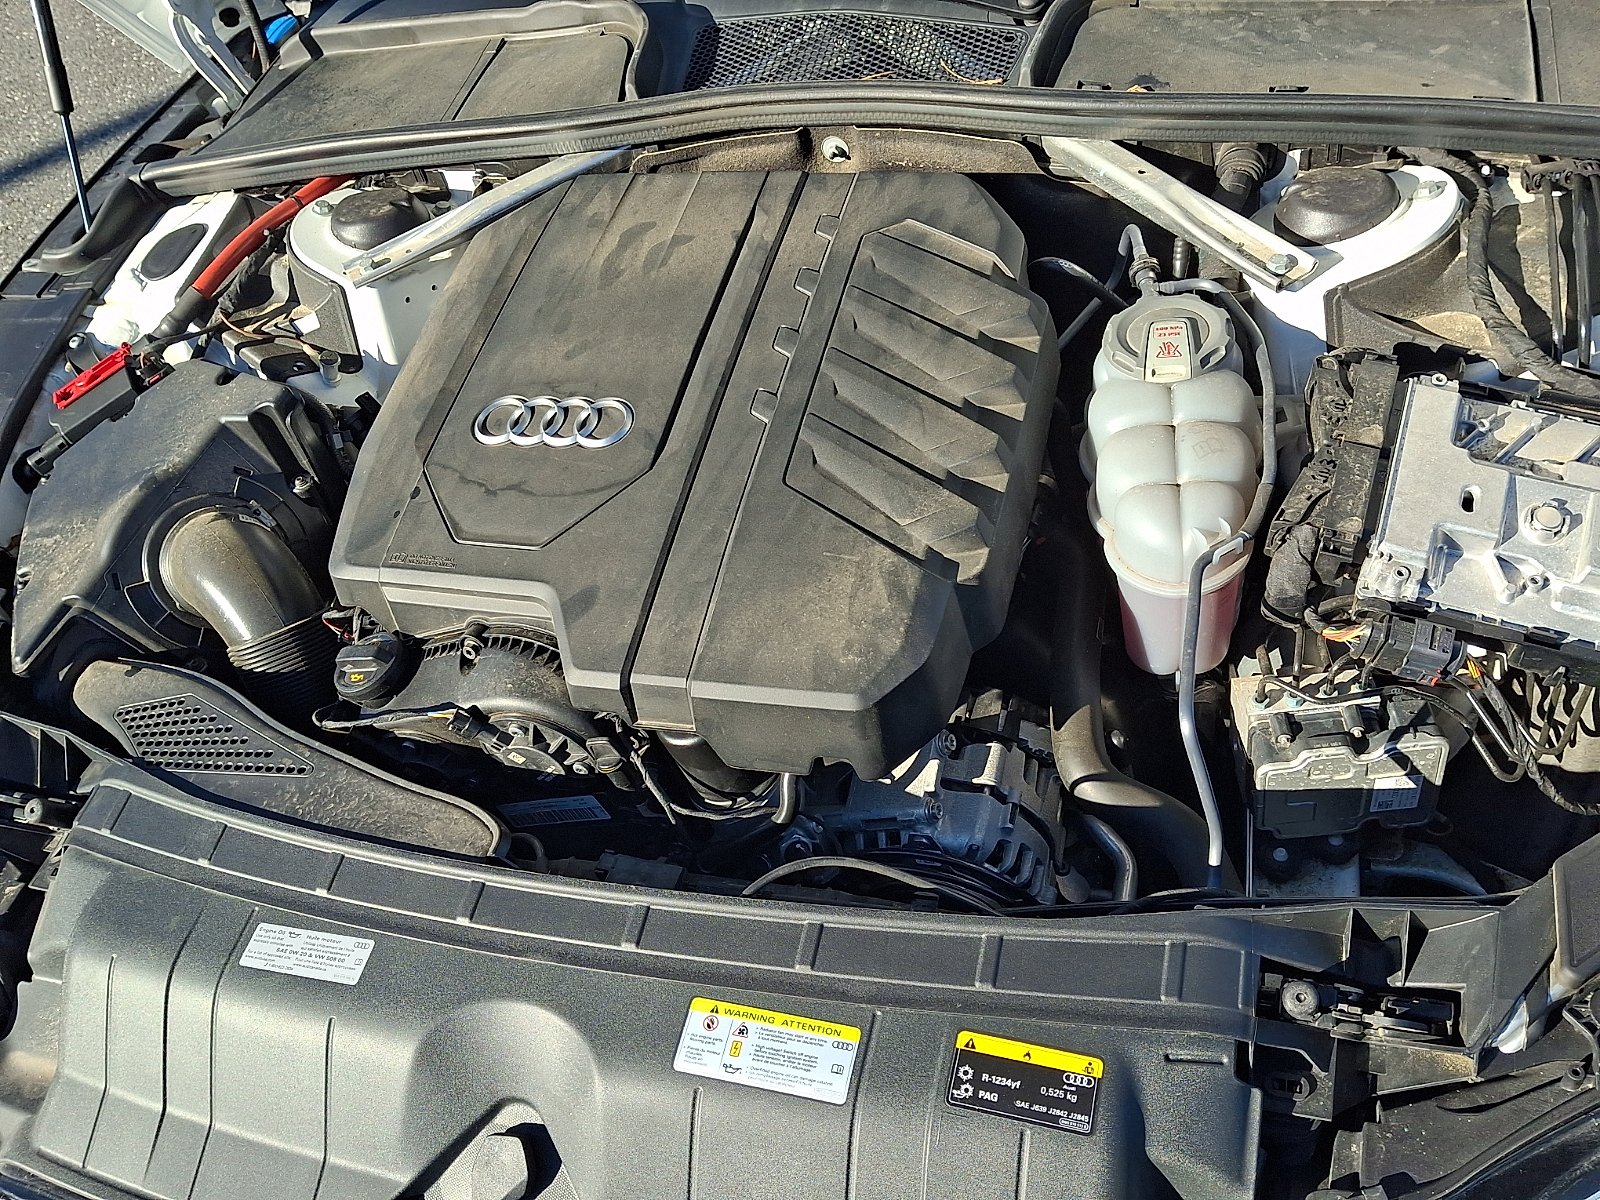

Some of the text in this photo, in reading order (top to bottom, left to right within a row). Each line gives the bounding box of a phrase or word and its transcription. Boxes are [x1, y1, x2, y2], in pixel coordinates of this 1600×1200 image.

[724, 1008, 842, 1036] WARNING ATTENTION
[982, 1073, 1021, 1090] R-1234yf
[978, 1090, 999, 1102] PAG
[1040, 1086, 1078, 1103] 0,525 kg
[1015, 1100, 1089, 1122] SAE J639 J2842 J2845
